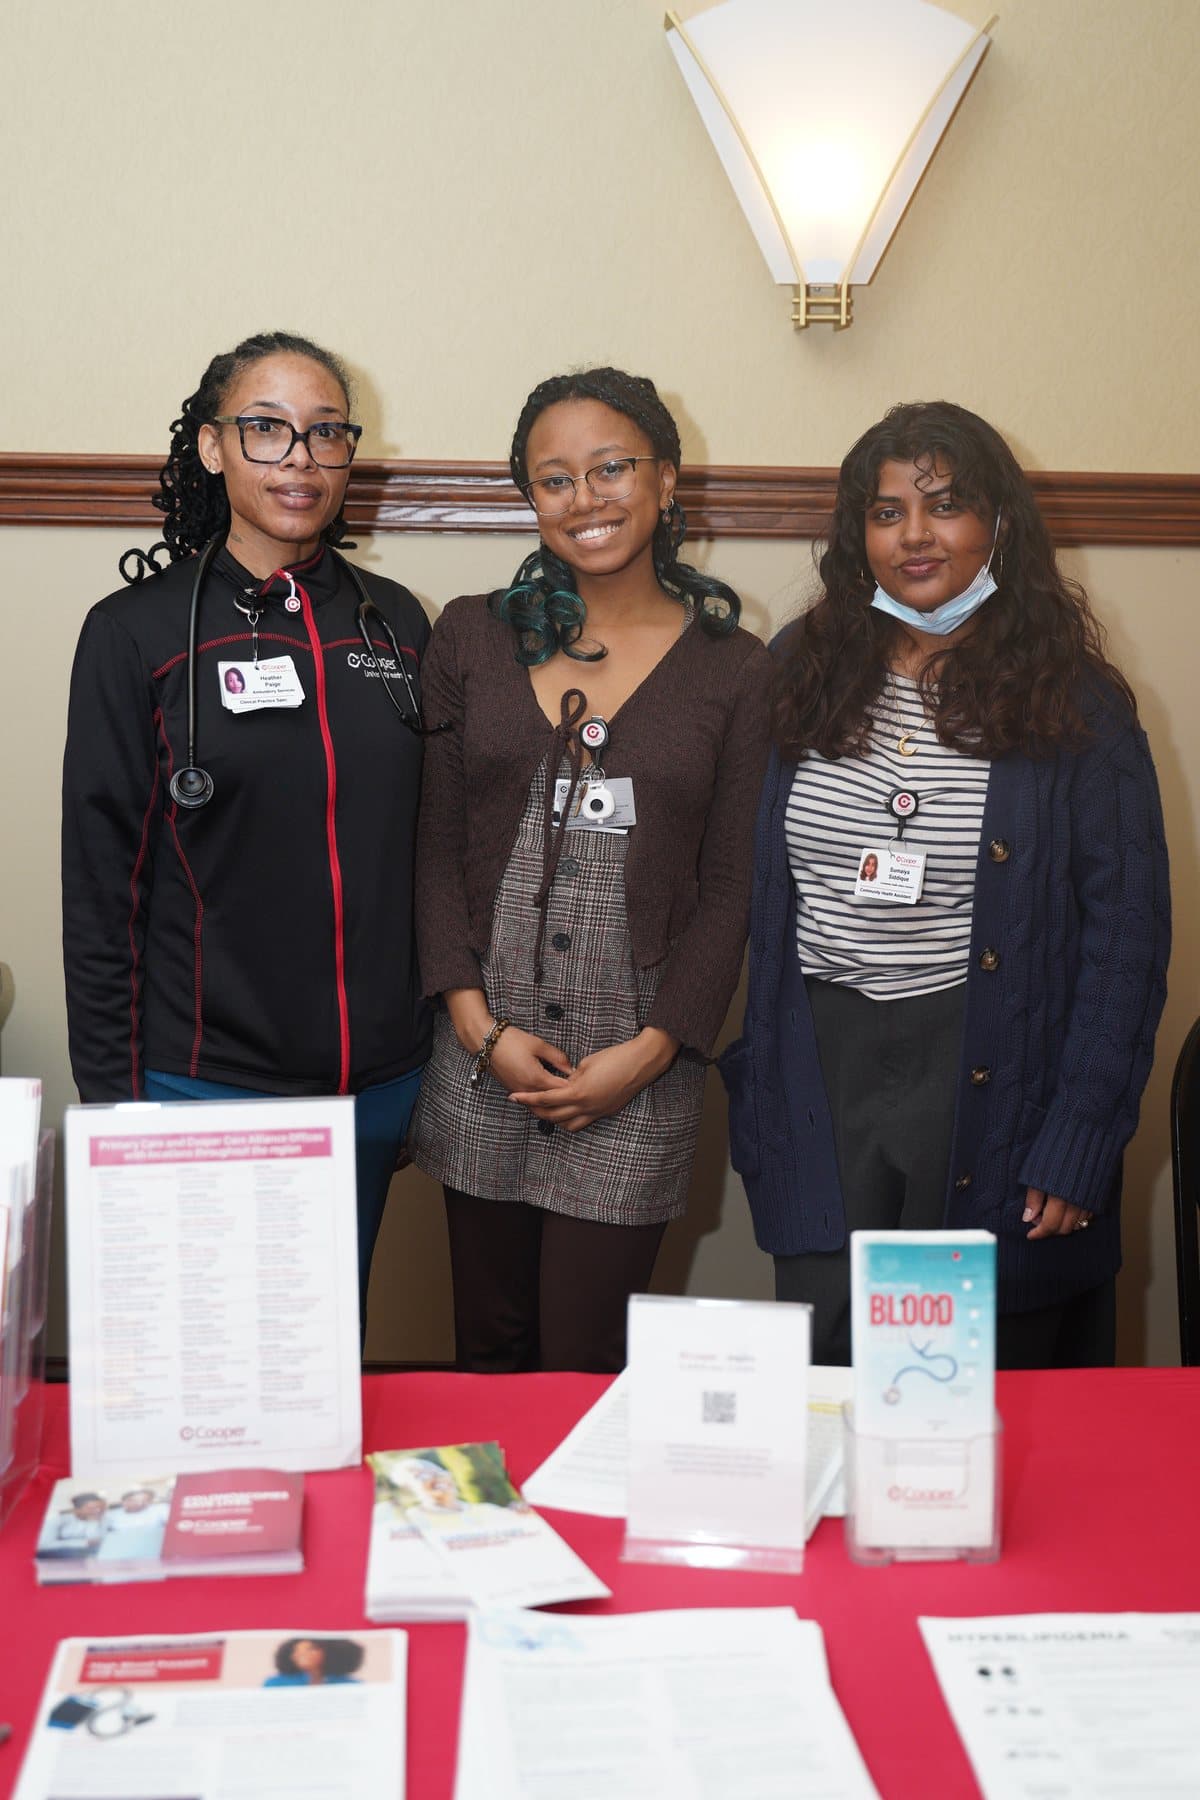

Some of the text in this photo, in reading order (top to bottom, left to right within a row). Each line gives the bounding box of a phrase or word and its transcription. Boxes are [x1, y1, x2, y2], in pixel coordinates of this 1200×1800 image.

[360, 653, 397, 670] Coper
[869, 1292, 954, 1326] BLOOD
[195, 1424, 247, 1440] Cooper
[947, 1631, 1130, 1643] HYPERLIPIDEMIA
